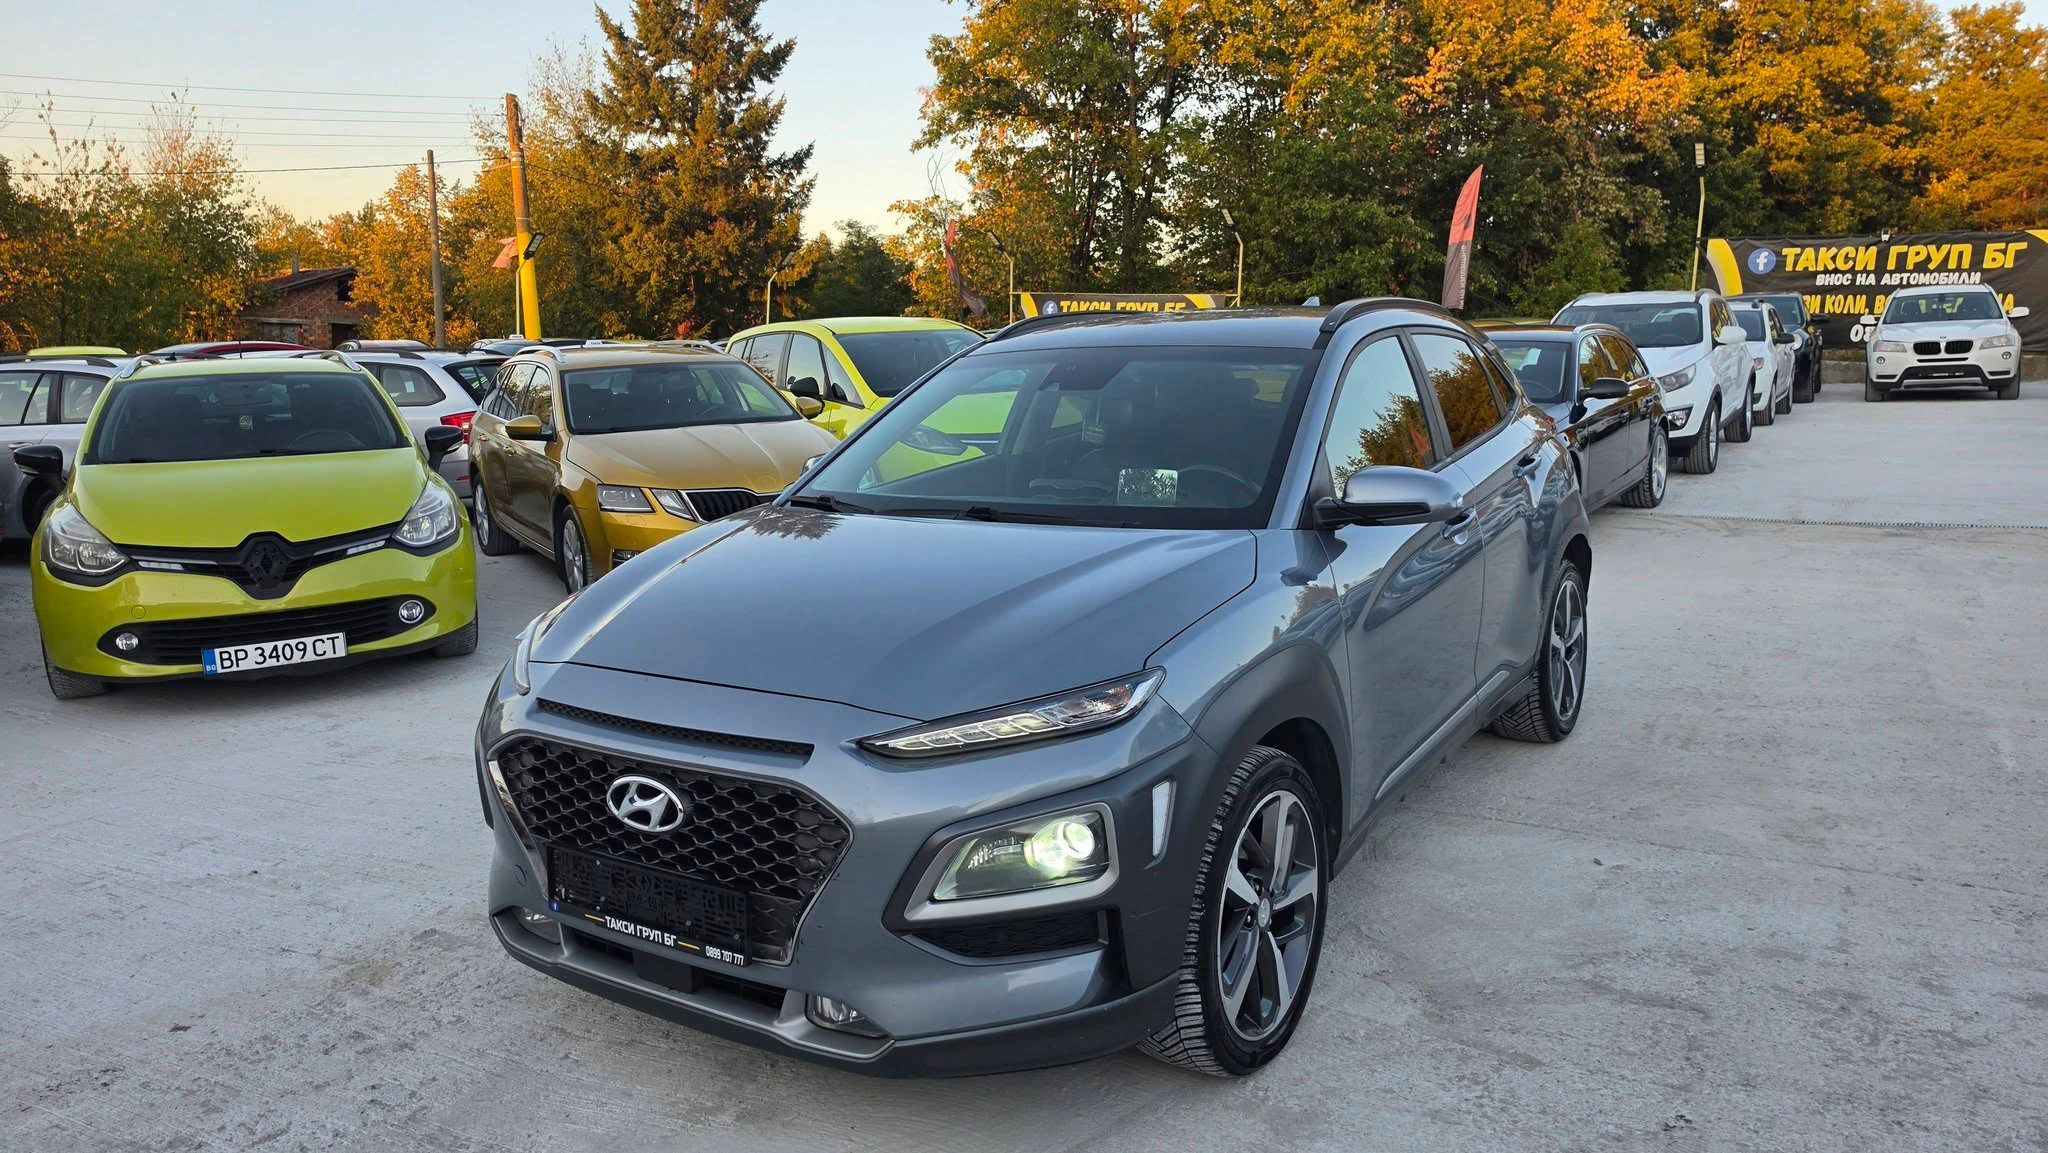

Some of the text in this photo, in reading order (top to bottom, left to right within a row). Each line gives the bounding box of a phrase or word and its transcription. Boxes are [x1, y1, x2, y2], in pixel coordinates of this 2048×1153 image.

[1781, 241, 2028, 272] ТАКСИ ГРУП БГ
[1816, 271, 1981, 286] ВНОС НА АВТОМОБИЛИ
[1824, 294, 1869, 316] КОЛИ,
[219, 649, 249, 670] BP
[254, 641, 307, 665] 3409
[312, 636, 340, 657] CT
[605, 915, 677, 947] ТАКСИ ГРУП БГ
[706, 945, 721, 959] 0899
